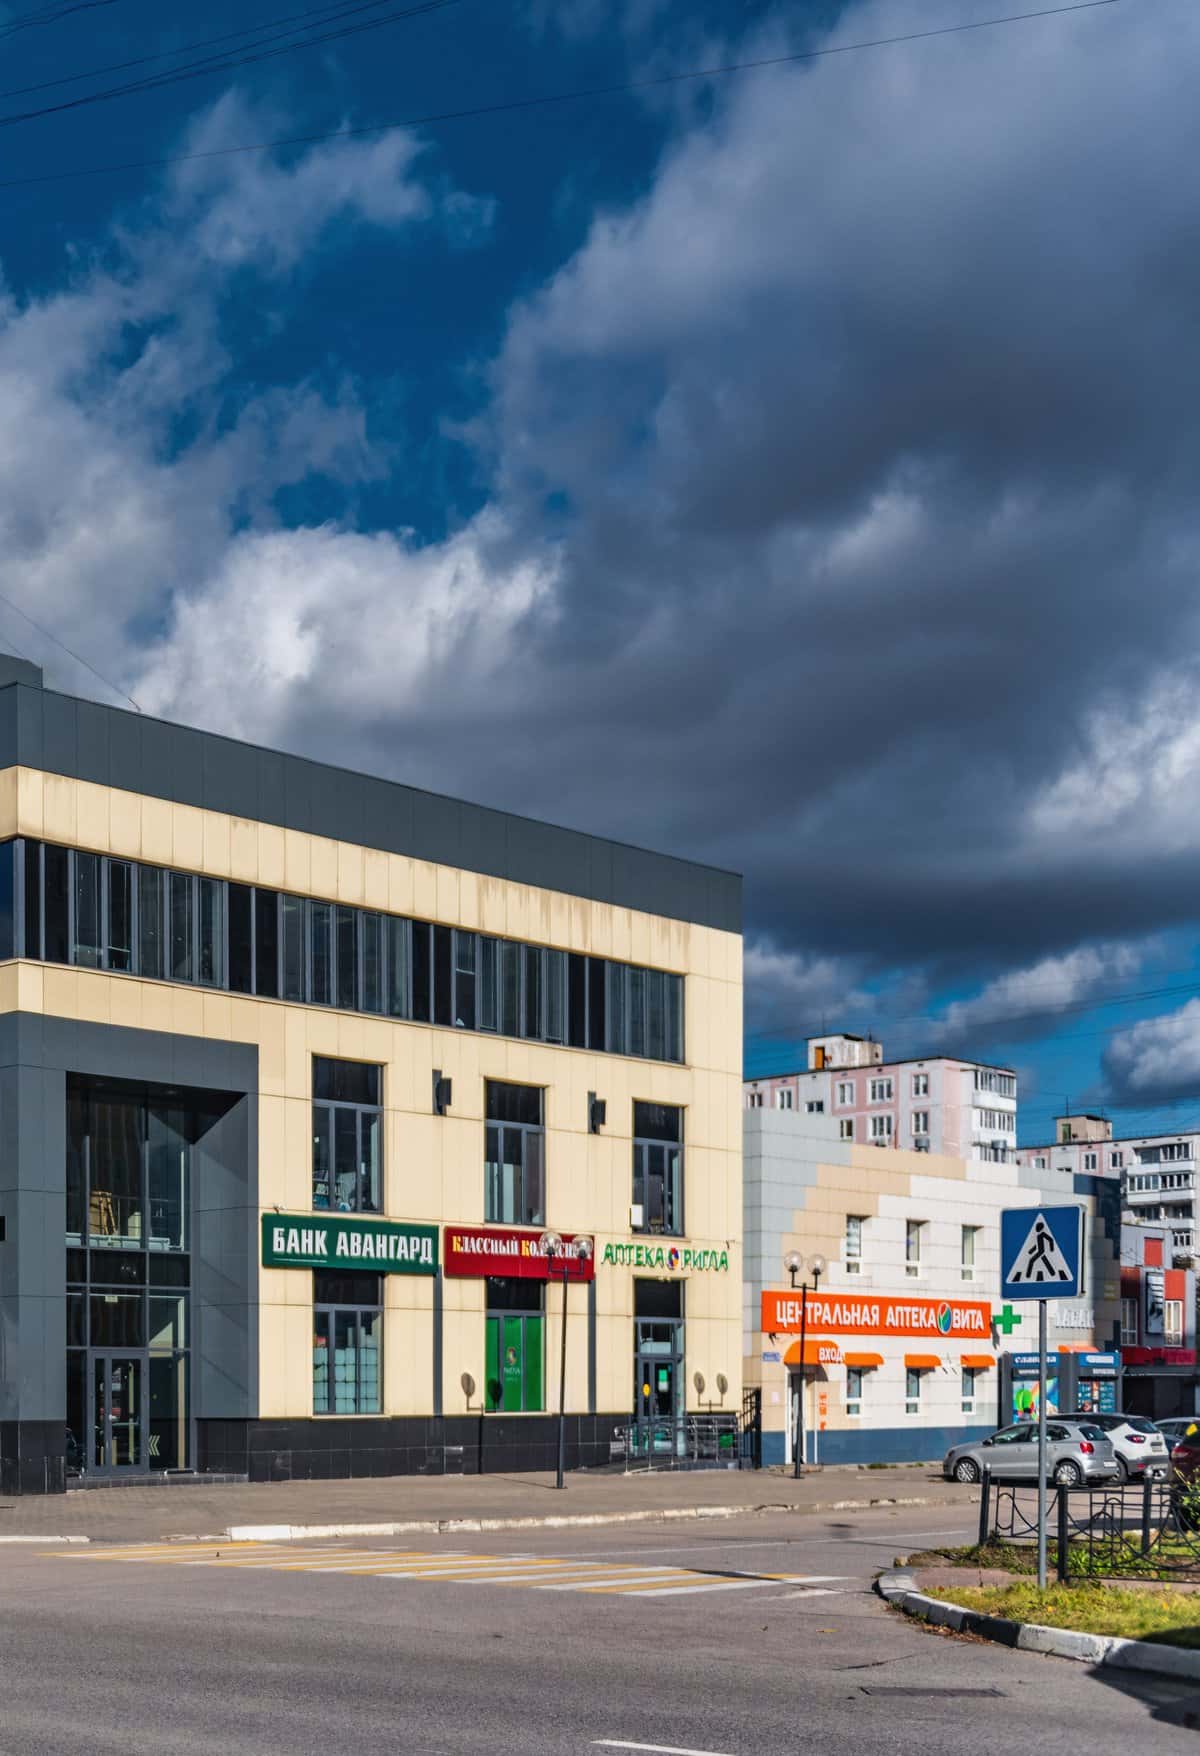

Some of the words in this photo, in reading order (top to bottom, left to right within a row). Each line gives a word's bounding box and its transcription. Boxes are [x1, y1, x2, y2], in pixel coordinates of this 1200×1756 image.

[272, 1227, 328, 1256] БАНК
[335, 1231, 433, 1265] АВАНГАРД
[601, 1243, 665, 1268] АПТЕКА
[682, 1249, 729, 1272] РИГЛА
[776, 1300, 880, 1327] ЦЕНТРАЛЬНАЯ
[886, 1305, 937, 1328] АПТЕКА
[951, 1308, 985, 1330] ВИТА
[818, 1347, 845, 1364] ВХОД
